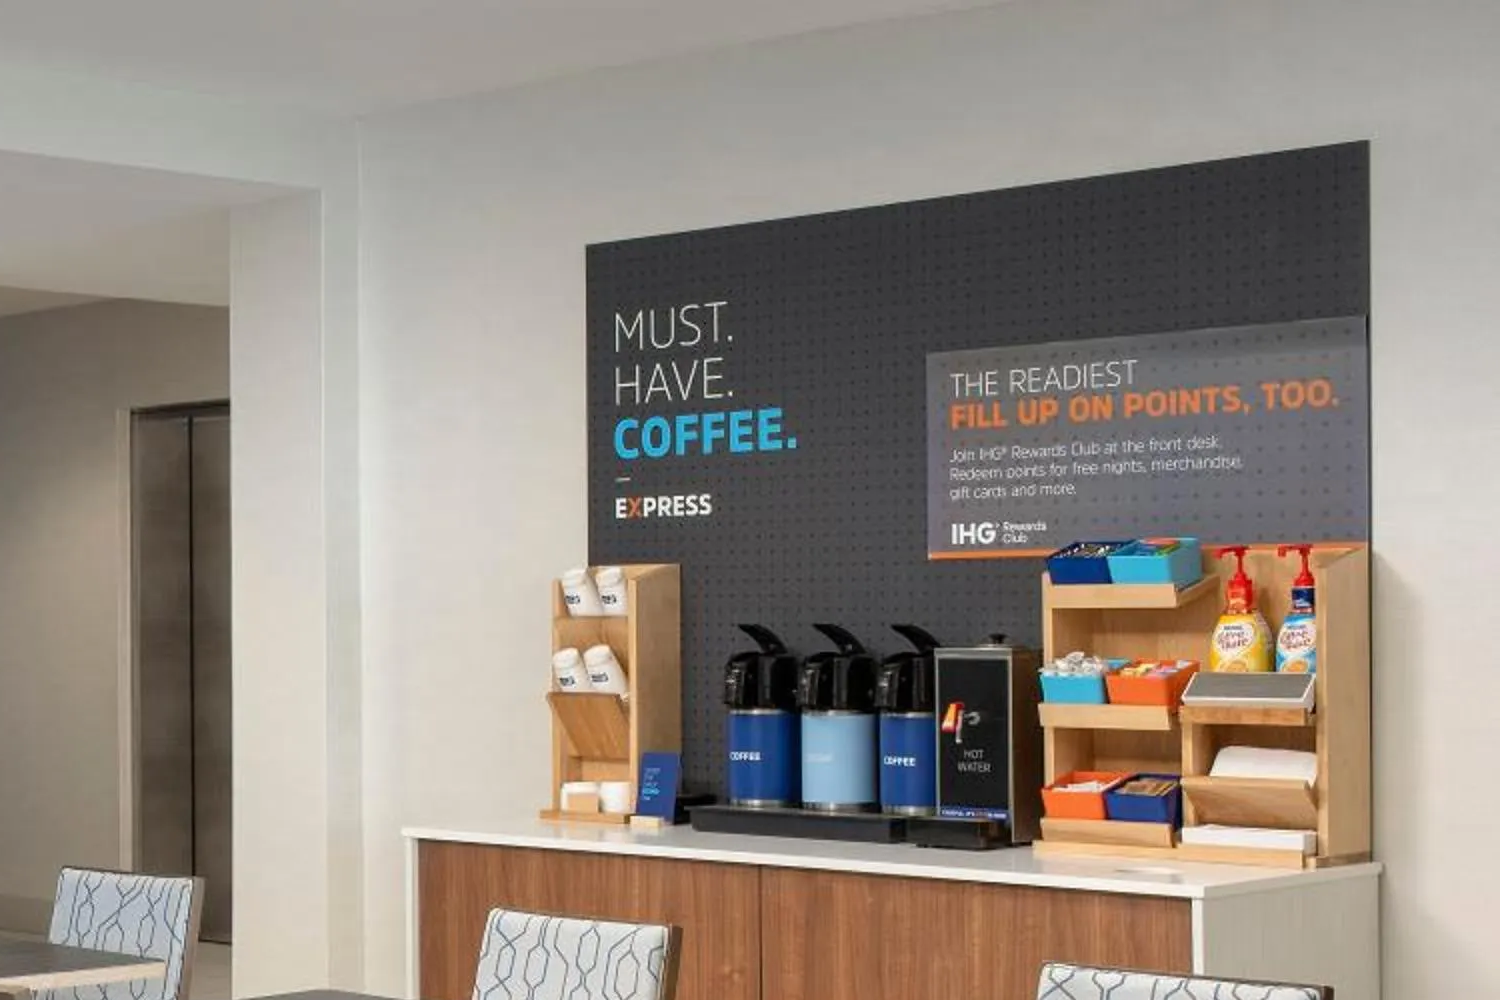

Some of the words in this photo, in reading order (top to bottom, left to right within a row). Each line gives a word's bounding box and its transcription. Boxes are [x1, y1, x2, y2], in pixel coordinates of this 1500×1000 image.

[614, 301, 733, 352] MUST.
[614, 357, 733, 406] HAVE.
[950, 370, 998, 398] THE
[1009, 359, 1138, 394] READIEST
[951, 401, 1007, 430] FILL
[1017, 397, 1058, 426] UP
[1069, 394, 1112, 423] ON
[1124, 385, 1250, 417] POINTS,
[1261, 378, 1339, 411] TOO.
[613, 407, 797, 460] COFFEE.
[950, 449, 975, 462] Join
[1011, 445, 1067, 459] Rewards
[1071, 440, 1100, 456] Club
[1103, 442, 1117, 454] at
[1121, 439, 1145, 453] the
[1149, 437, 1181, 451] front
[950, 467, 1003, 480] Redeem
[1006, 464, 1047, 480] points
[1049, 462, 1068, 477] for
[1072, 462, 1099, 475] free
[949, 486, 971, 501] gift
[973, 486, 1006, 499] cards
[1011, 484, 1036, 497] and
[1040, 483, 1077, 496] more.
[615, 494, 712, 519] EXPRESS
[1003, 520, 1047, 532] Rewards
[1003, 532, 1028, 544] Club
[883, 755, 916, 767] COFFEE
[963, 748, 984, 759] HOT
[957, 761, 991, 773] WATER
